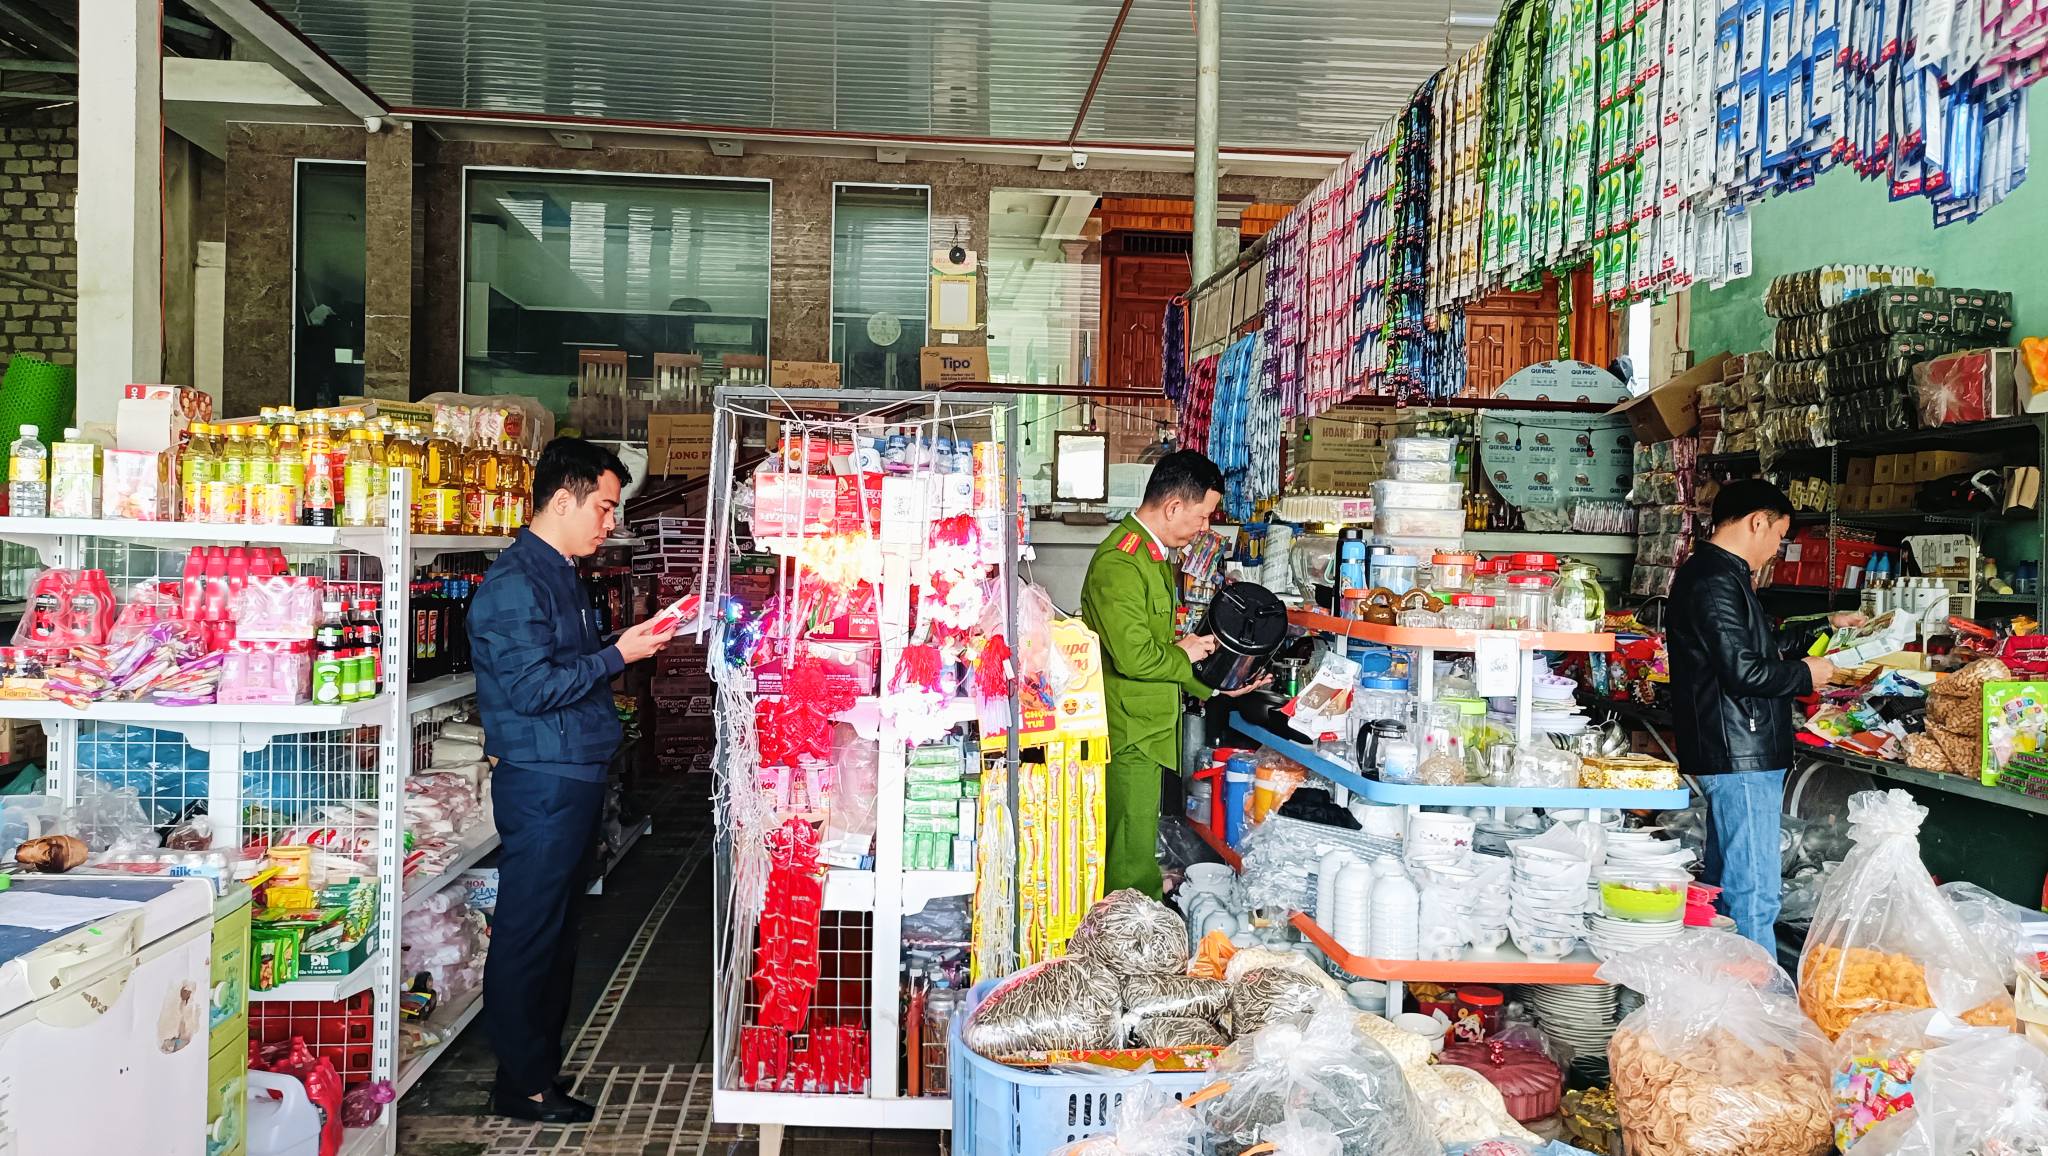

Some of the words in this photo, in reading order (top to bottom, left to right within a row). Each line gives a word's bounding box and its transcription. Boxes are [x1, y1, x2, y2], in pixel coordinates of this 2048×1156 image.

[941, 356, 970, 371] Tipo
[670, 451, 698, 460] LONG
[661, 577, 692, 586] KOKOMI
[1062, 642, 1090, 657] upa
